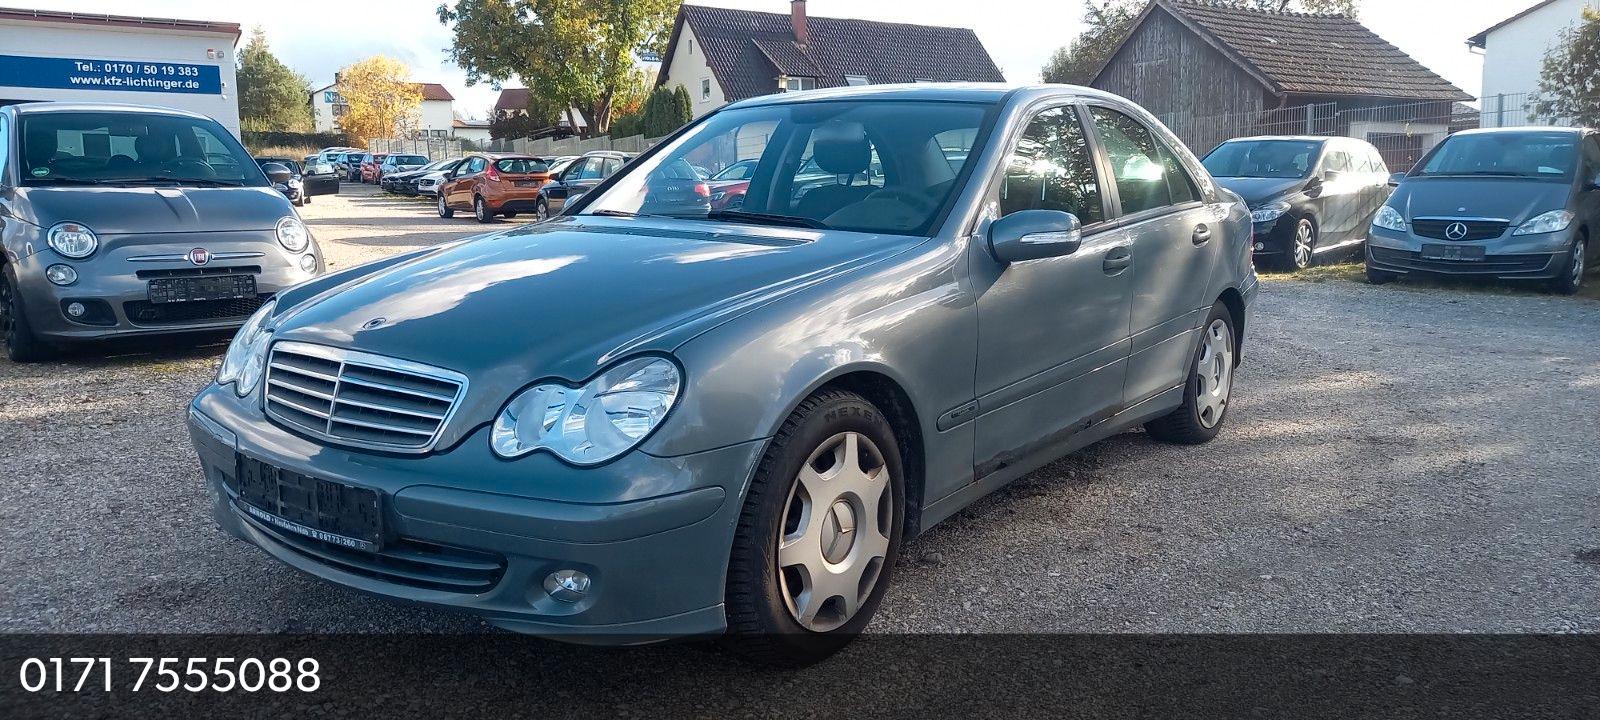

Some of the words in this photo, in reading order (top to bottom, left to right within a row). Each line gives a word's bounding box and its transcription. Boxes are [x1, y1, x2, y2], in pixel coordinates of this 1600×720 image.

[75, 62, 101, 72] Tel.:
[104, 63, 133, 74] 0170
[136, 64, 141, 74] /
[143, 65, 158, 75] 50
[161, 66, 175, 75] 19
[177, 66, 199, 77] 383
[70, 75, 199, 89] www.kfz-lichtinger.de
